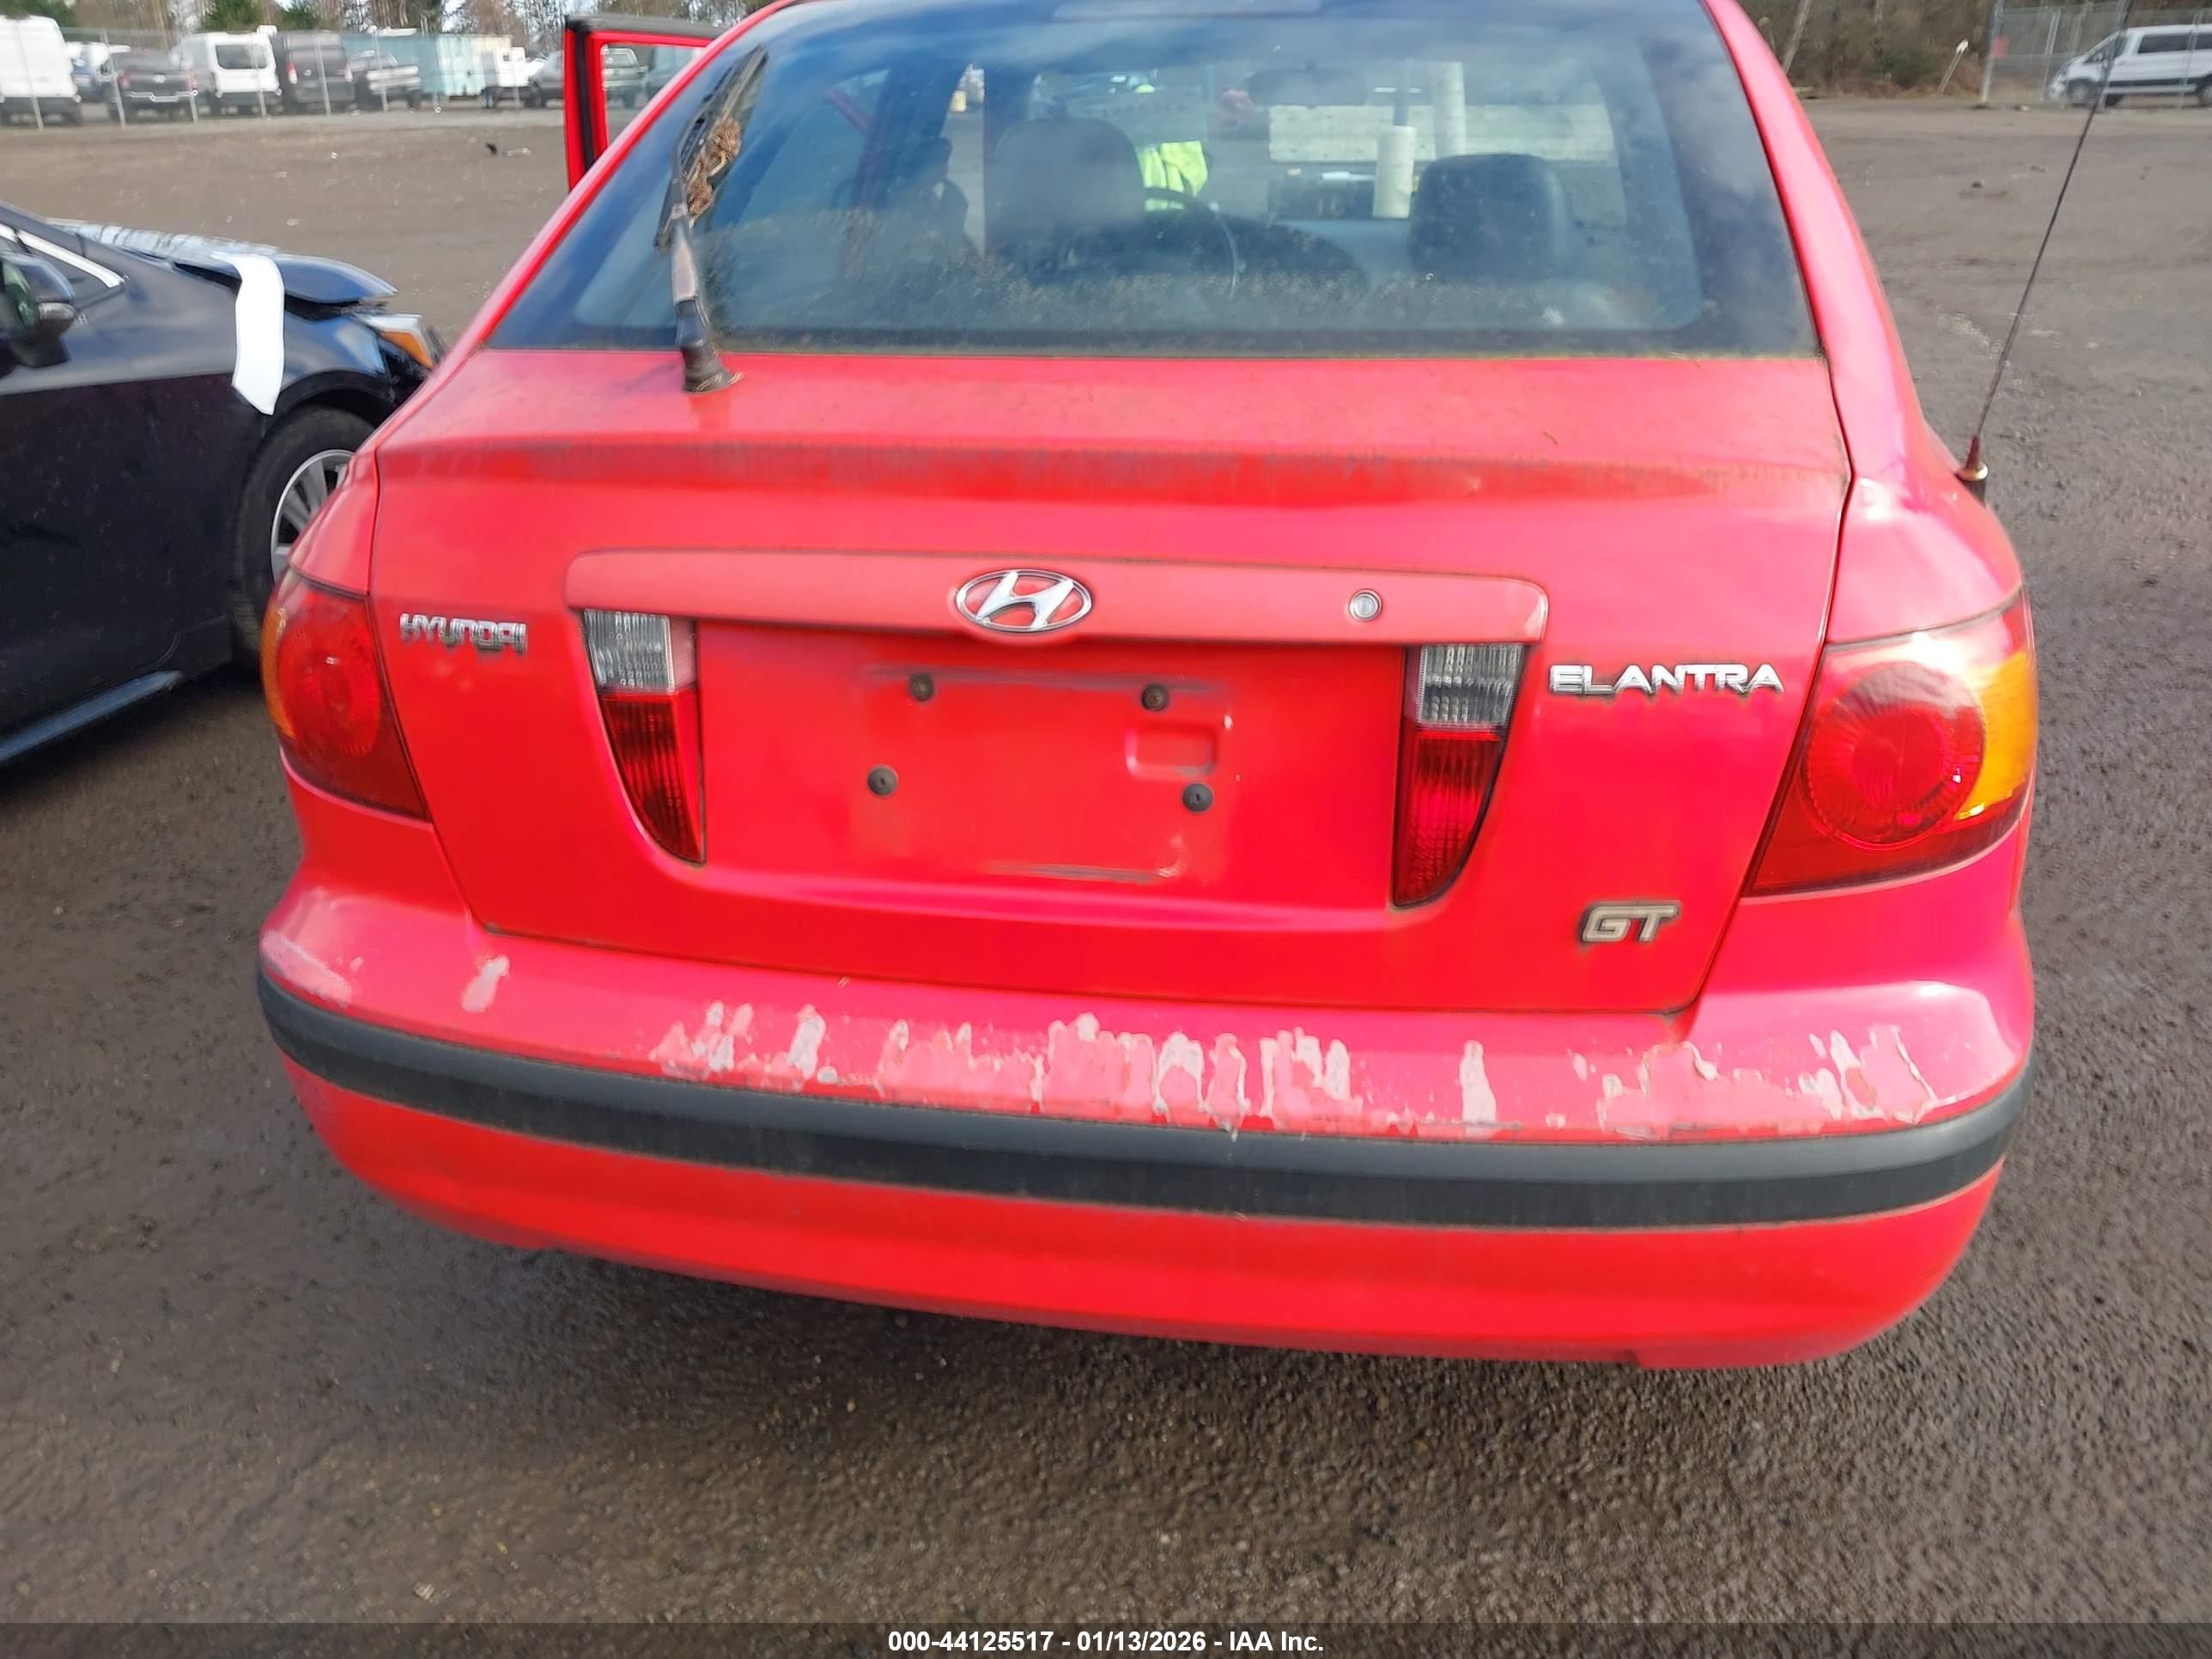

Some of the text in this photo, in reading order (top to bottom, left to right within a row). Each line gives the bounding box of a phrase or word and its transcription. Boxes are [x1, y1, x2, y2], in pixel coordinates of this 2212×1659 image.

[399, 612, 528, 653] HYUNDAI
[1549, 663, 1785, 696] ELANTRA
[1581, 903, 1680, 943] GT
